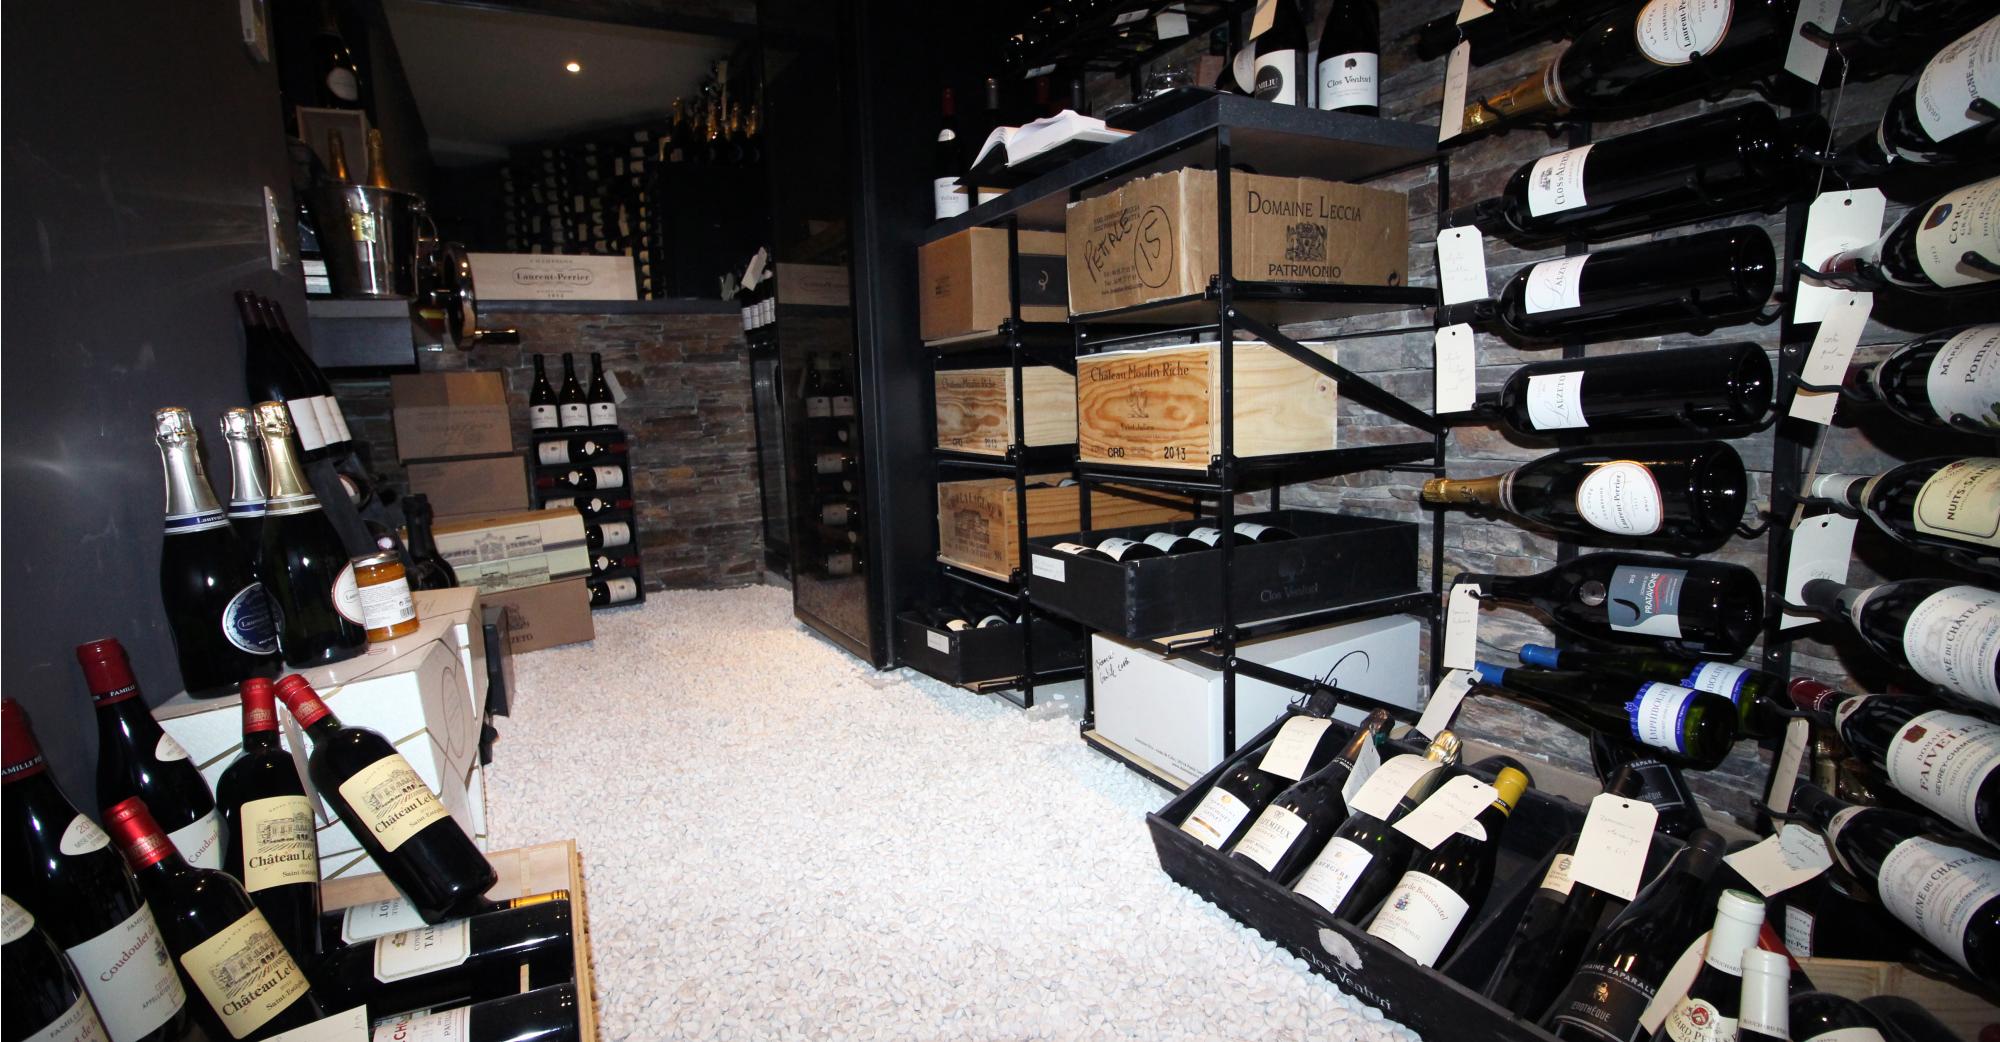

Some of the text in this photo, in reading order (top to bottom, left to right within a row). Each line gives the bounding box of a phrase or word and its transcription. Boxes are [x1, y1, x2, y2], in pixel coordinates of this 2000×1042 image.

[1679, 0, 1691, 47] Laurent-Pe
[1326, 80, 1343, 89] Clos
[1554, 181, 1566, 205] CLOS
[1319, 196, 1362, 222] LECCIA
[1139, 217, 1161, 271] 15
[516, 272, 591, 282] Laurent-Perrier
[1268, 263, 1342, 279] PATRIMONIO
[1128, 362, 1160, 379] Moulin
[1163, 360, 1190, 377] Riche
[1965, 336, 1999, 384] Pomm
[1164, 446, 1187, 460] 2013
[1613, 475, 1630, 529] Laurent-Perrier
[1644, 572, 1660, 614] PRATAVONE
[510, 633, 534, 644] ZETO
[1943, 658, 1960, 687] AUNE
[1, 759, 34, 776] AMILLE
[1631, 759, 1661, 769] SAPARA
[374, 803, 419, 834] Château
[188, 831, 218, 864] Coudoul
[249, 855, 300, 869] Château
[1913, 891, 1926, 922] AUNE
[100, 933, 150, 983] Coudoulet
[1300, 946, 1391, 1010] Clos Venturi
[1607, 967, 1656, 995] SAPARALE
[222, 977, 278, 1017] Château
[1672, 1013, 1693, 1037] HARD
[1743, 1018, 1776, 1031] BOUCHRD
